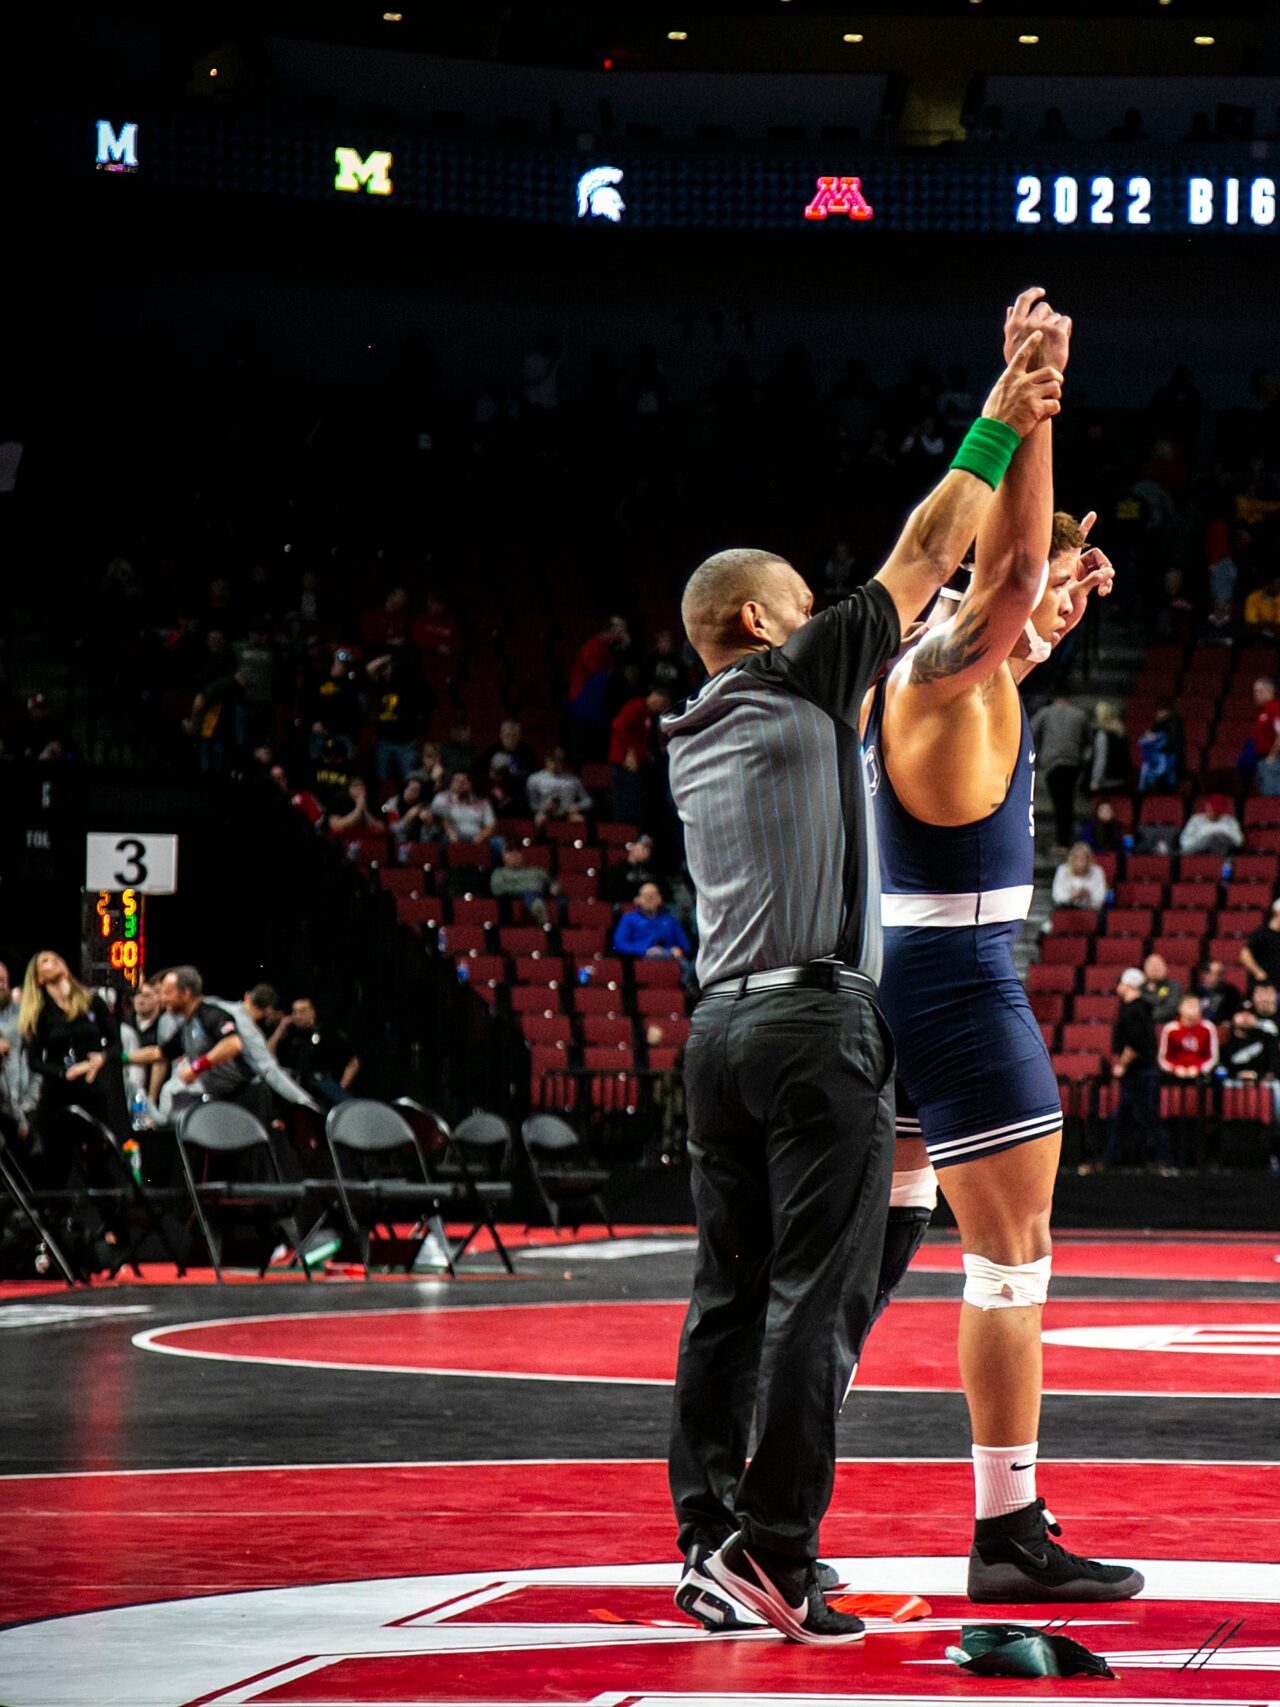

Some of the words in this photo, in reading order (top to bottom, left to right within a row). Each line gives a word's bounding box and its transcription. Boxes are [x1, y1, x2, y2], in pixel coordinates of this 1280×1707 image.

[95, 119, 139, 167] M
[334, 146, 394, 196] M
[803, 175, 875, 221] M
[1014, 174, 1152, 226] 2022
[1187, 176, 1276, 226] BIG
[114, 839, 148, 886] 3
